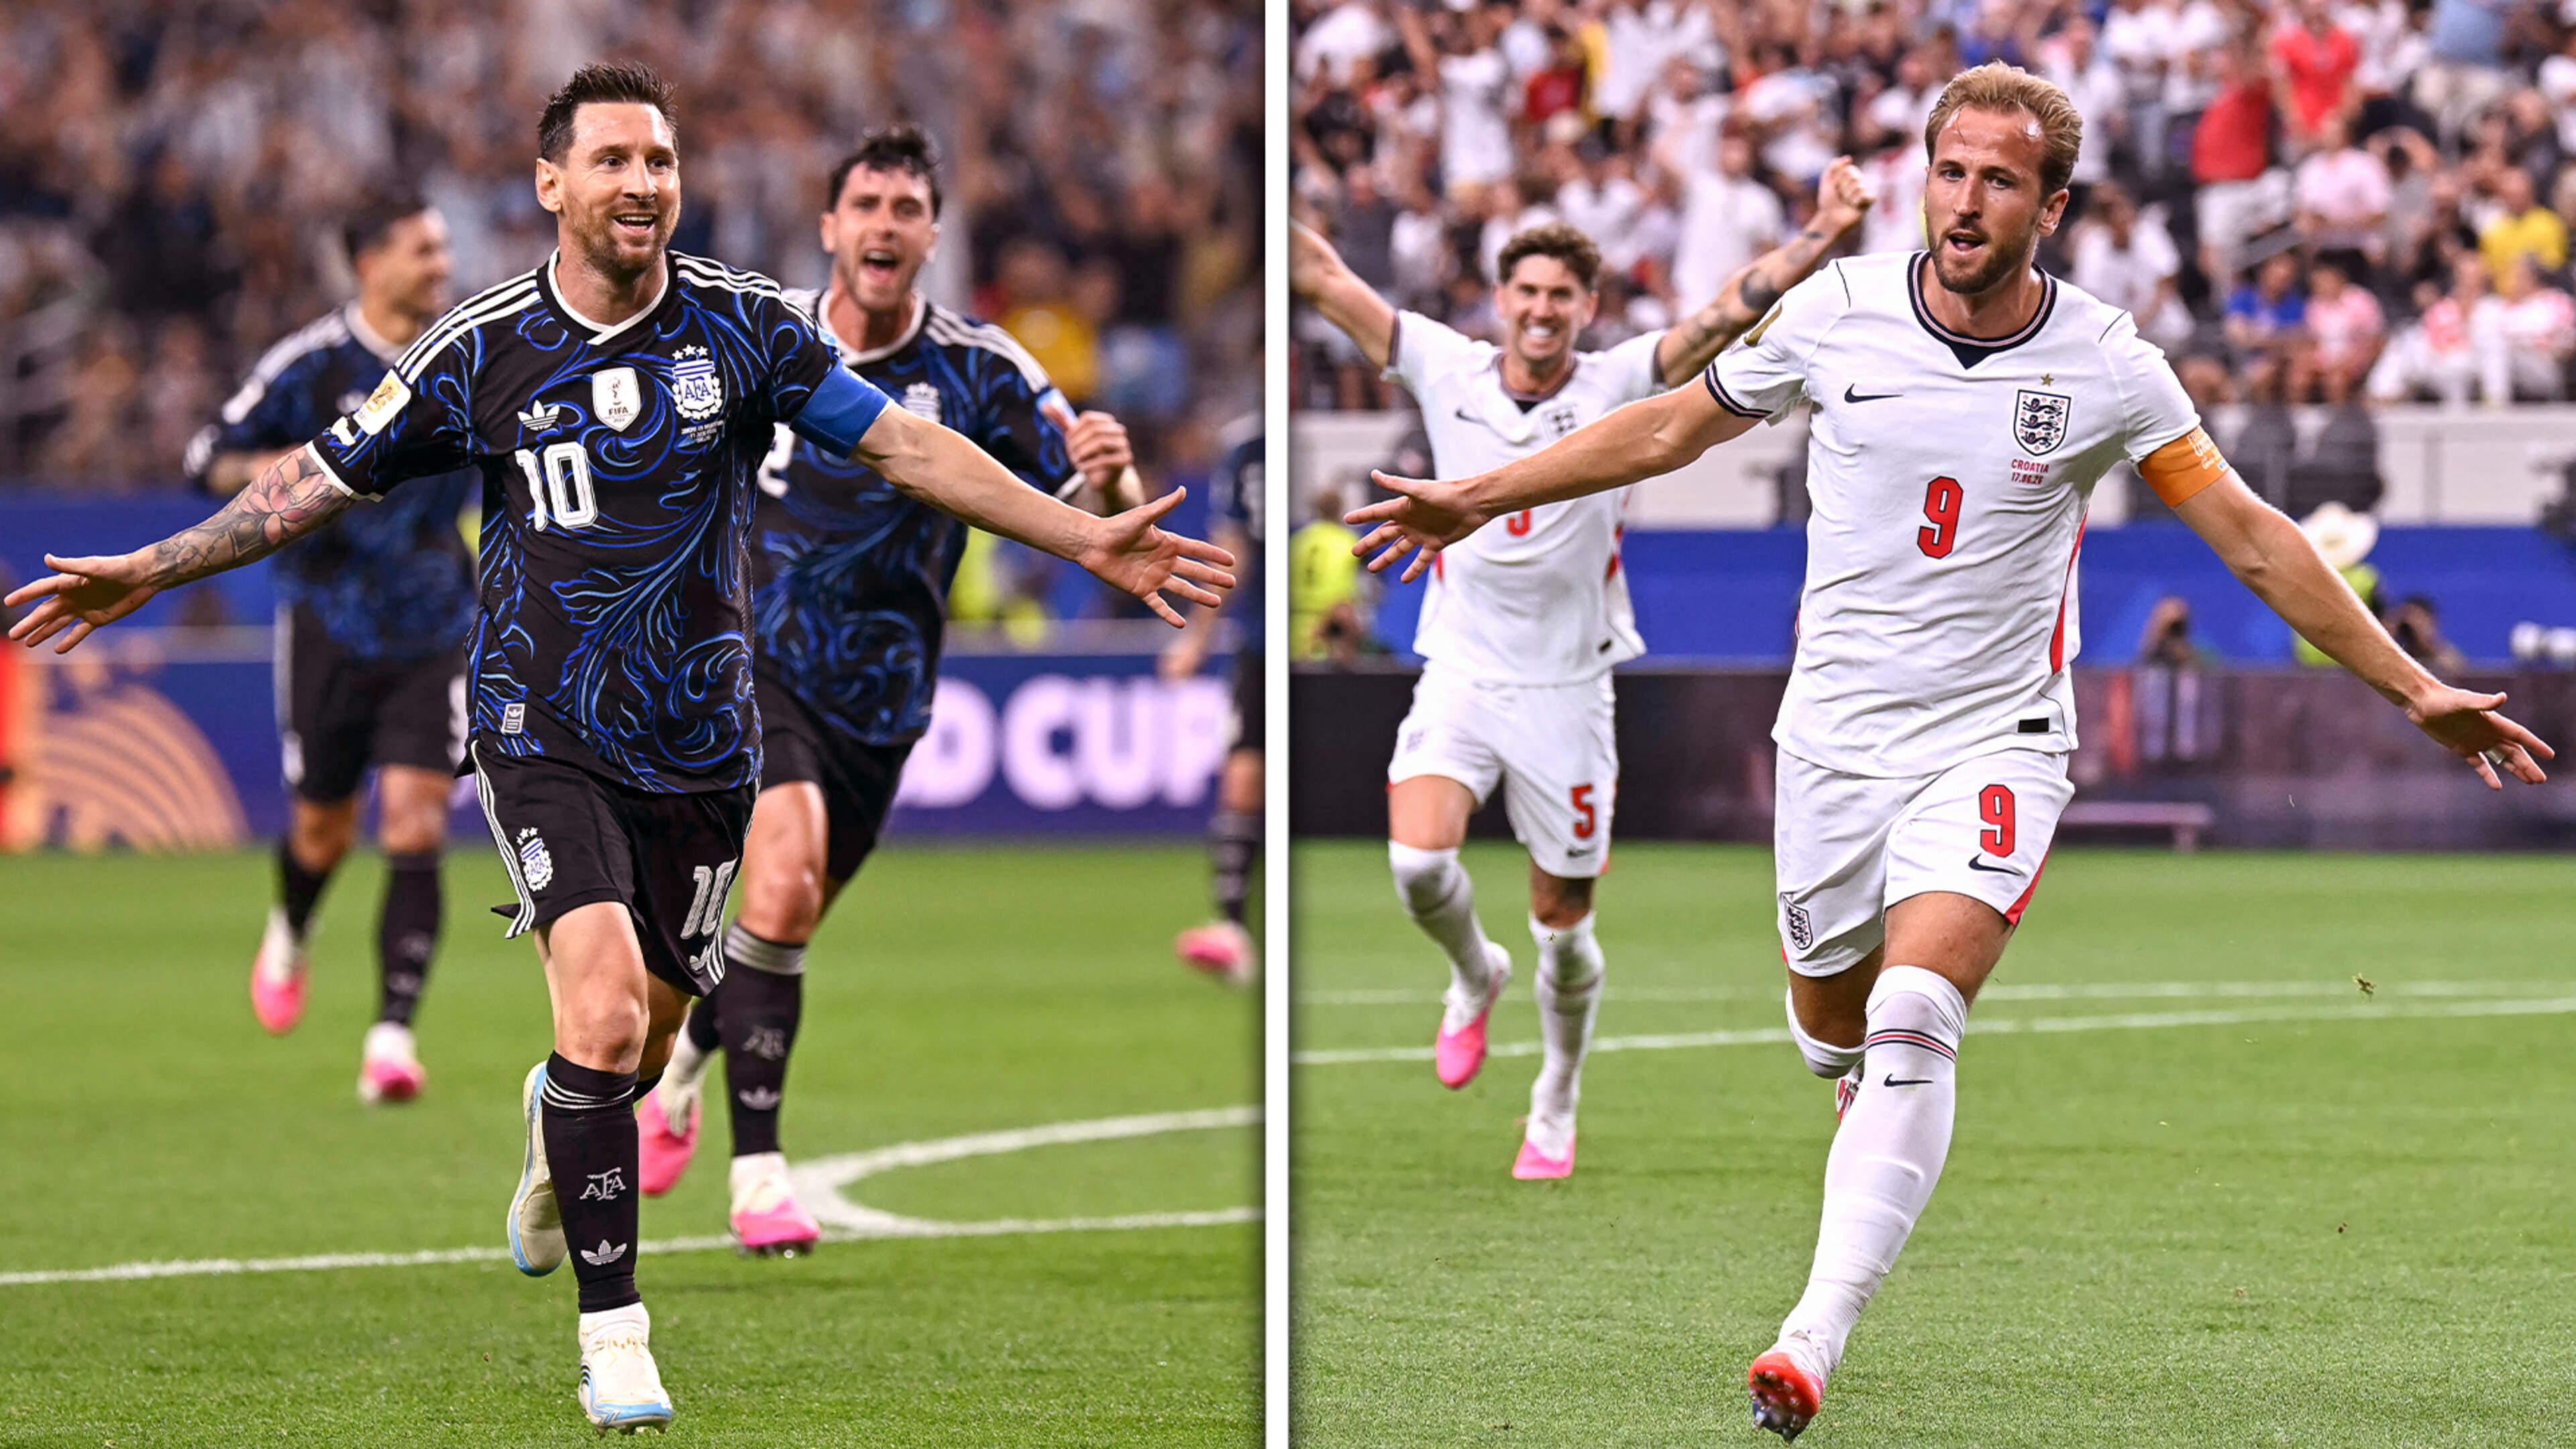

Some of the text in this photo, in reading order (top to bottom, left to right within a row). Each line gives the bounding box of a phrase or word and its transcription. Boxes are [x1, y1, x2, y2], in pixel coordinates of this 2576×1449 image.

[608, 407, 629, 415] FIFA
[684, 376, 711, 401] AFA
[515, 441, 598, 532] 10
[2011, 459, 2049, 473] CROATIA
[1917, 476, 1964, 559] 9
[1006, 674, 1242, 811] CUP
[1570, 784, 1595, 840] 5
[1979, 784, 2015, 858] 9
[580, 1167, 627, 1201] AFA
